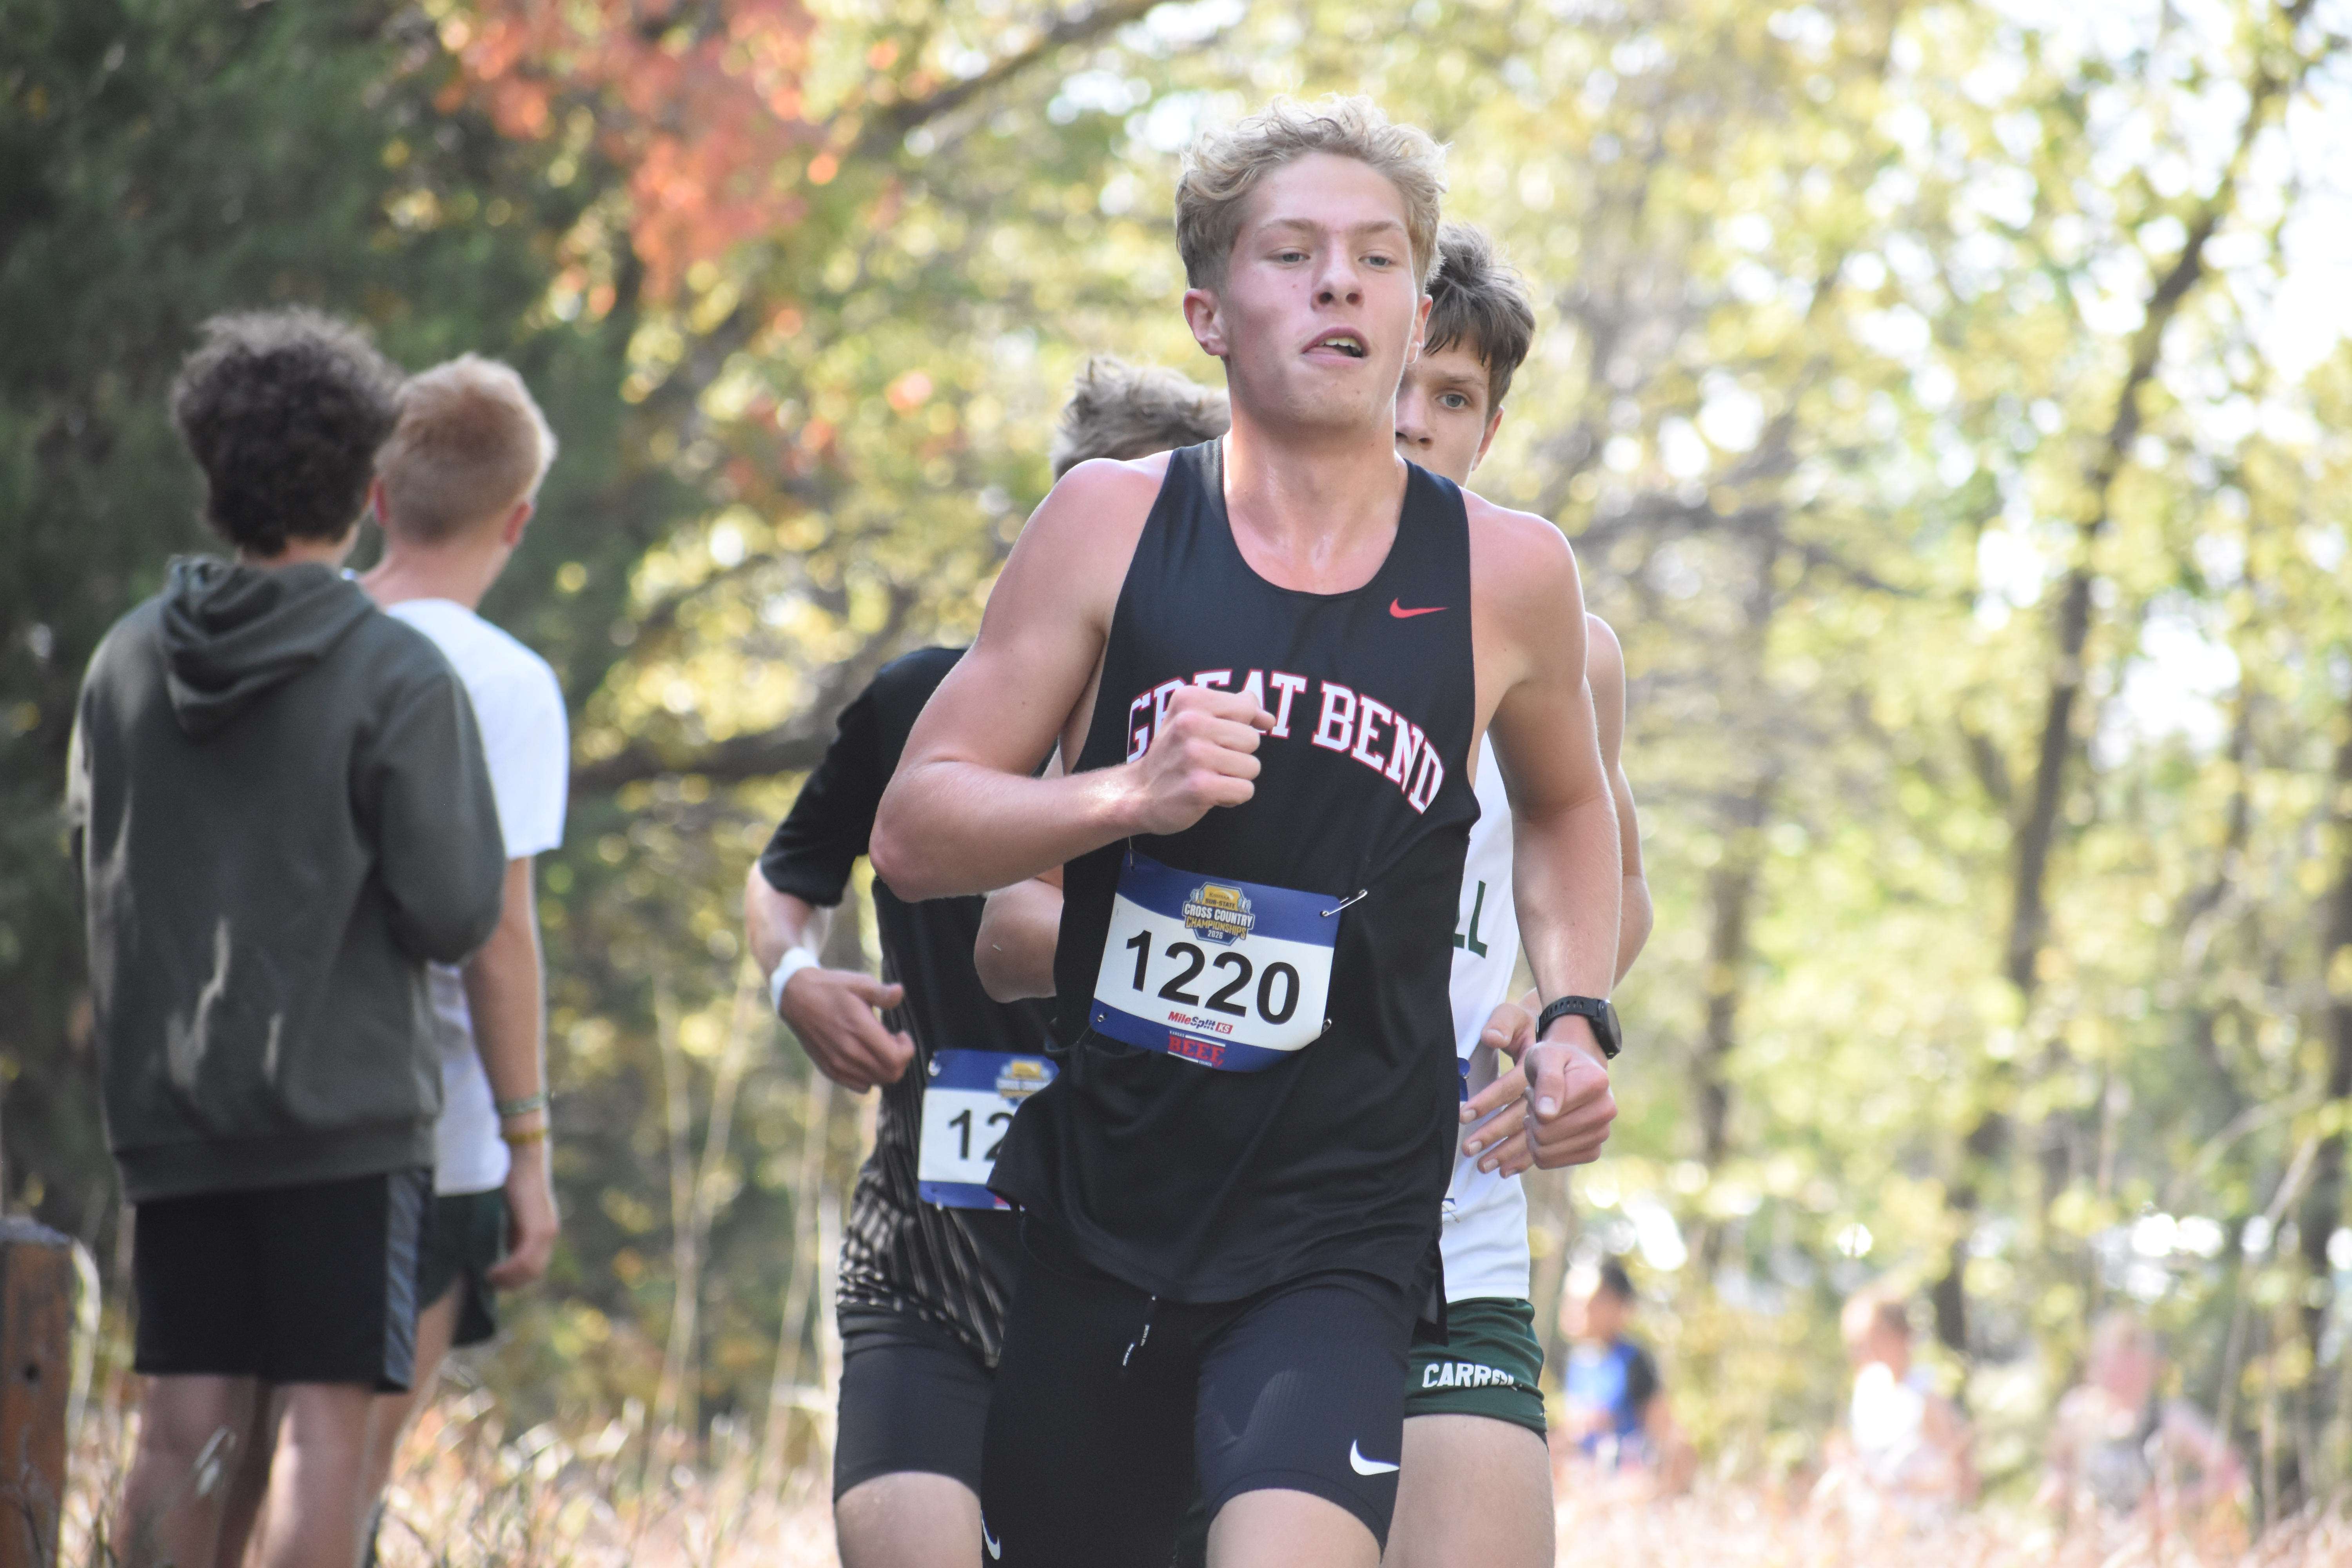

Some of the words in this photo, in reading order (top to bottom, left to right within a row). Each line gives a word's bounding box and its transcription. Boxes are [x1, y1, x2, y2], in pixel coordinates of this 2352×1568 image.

[1311, 680, 1444, 814] BEND
[1185, 904, 1212, 919] CROSS
[1214, 909, 1253, 927] COUNTRY
[1186, 916, 1247, 940] CHAMPIONSHIPS
[1207, 929, 1223, 939] 2026
[1126, 930, 1300, 1025] 1220
[1218, 1024, 1230, 1033] KS
[1422, 1361, 1523, 1391] CARRO
